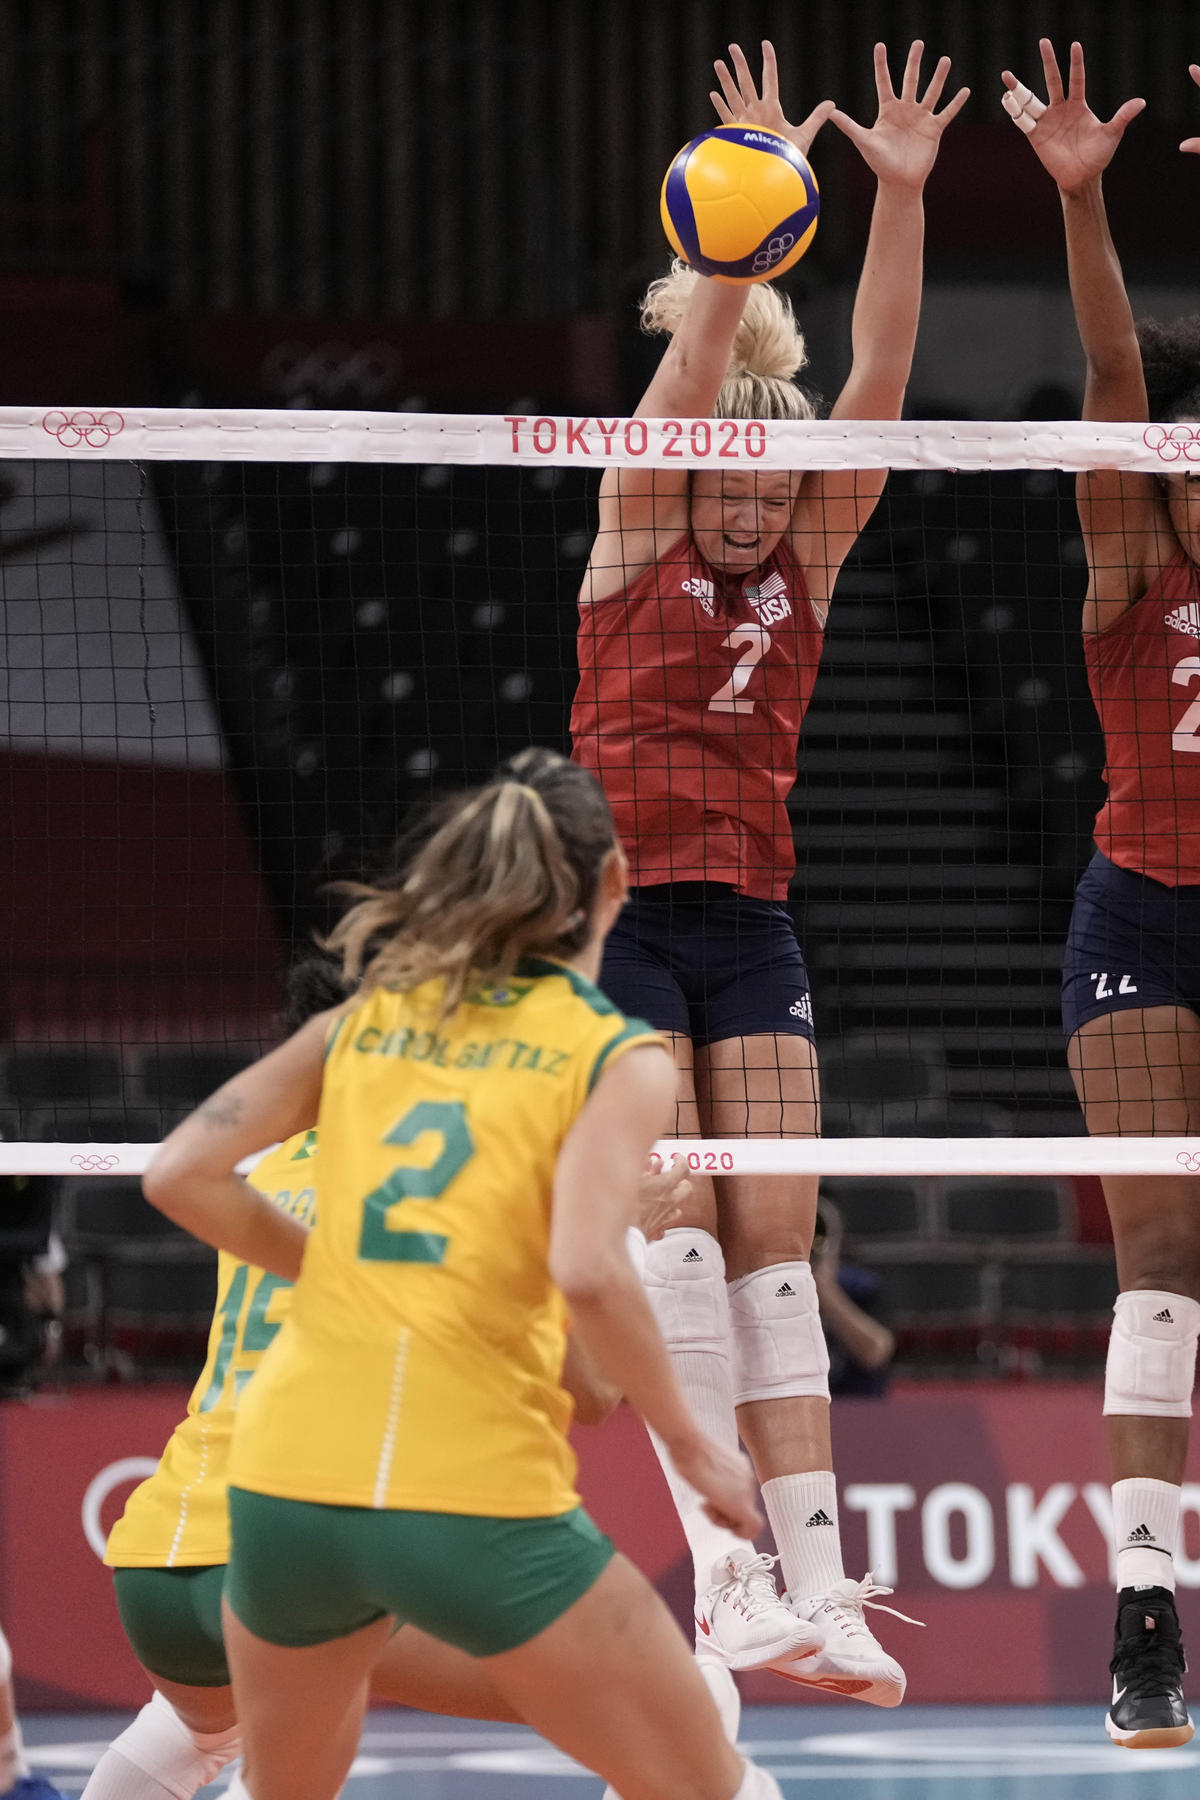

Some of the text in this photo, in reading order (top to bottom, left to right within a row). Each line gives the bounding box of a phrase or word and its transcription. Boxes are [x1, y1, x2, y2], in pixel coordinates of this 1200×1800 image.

[744, 132, 785, 151] MiKA
[504, 417, 766, 458] TOKYO 2020
[755, 594, 792, 627] USA
[708, 622, 771, 714] 2
[357, 1100, 476, 1265] 2
[805, 1519, 834, 1528] adidas
[1127, 1534, 1156, 1542] adidas
